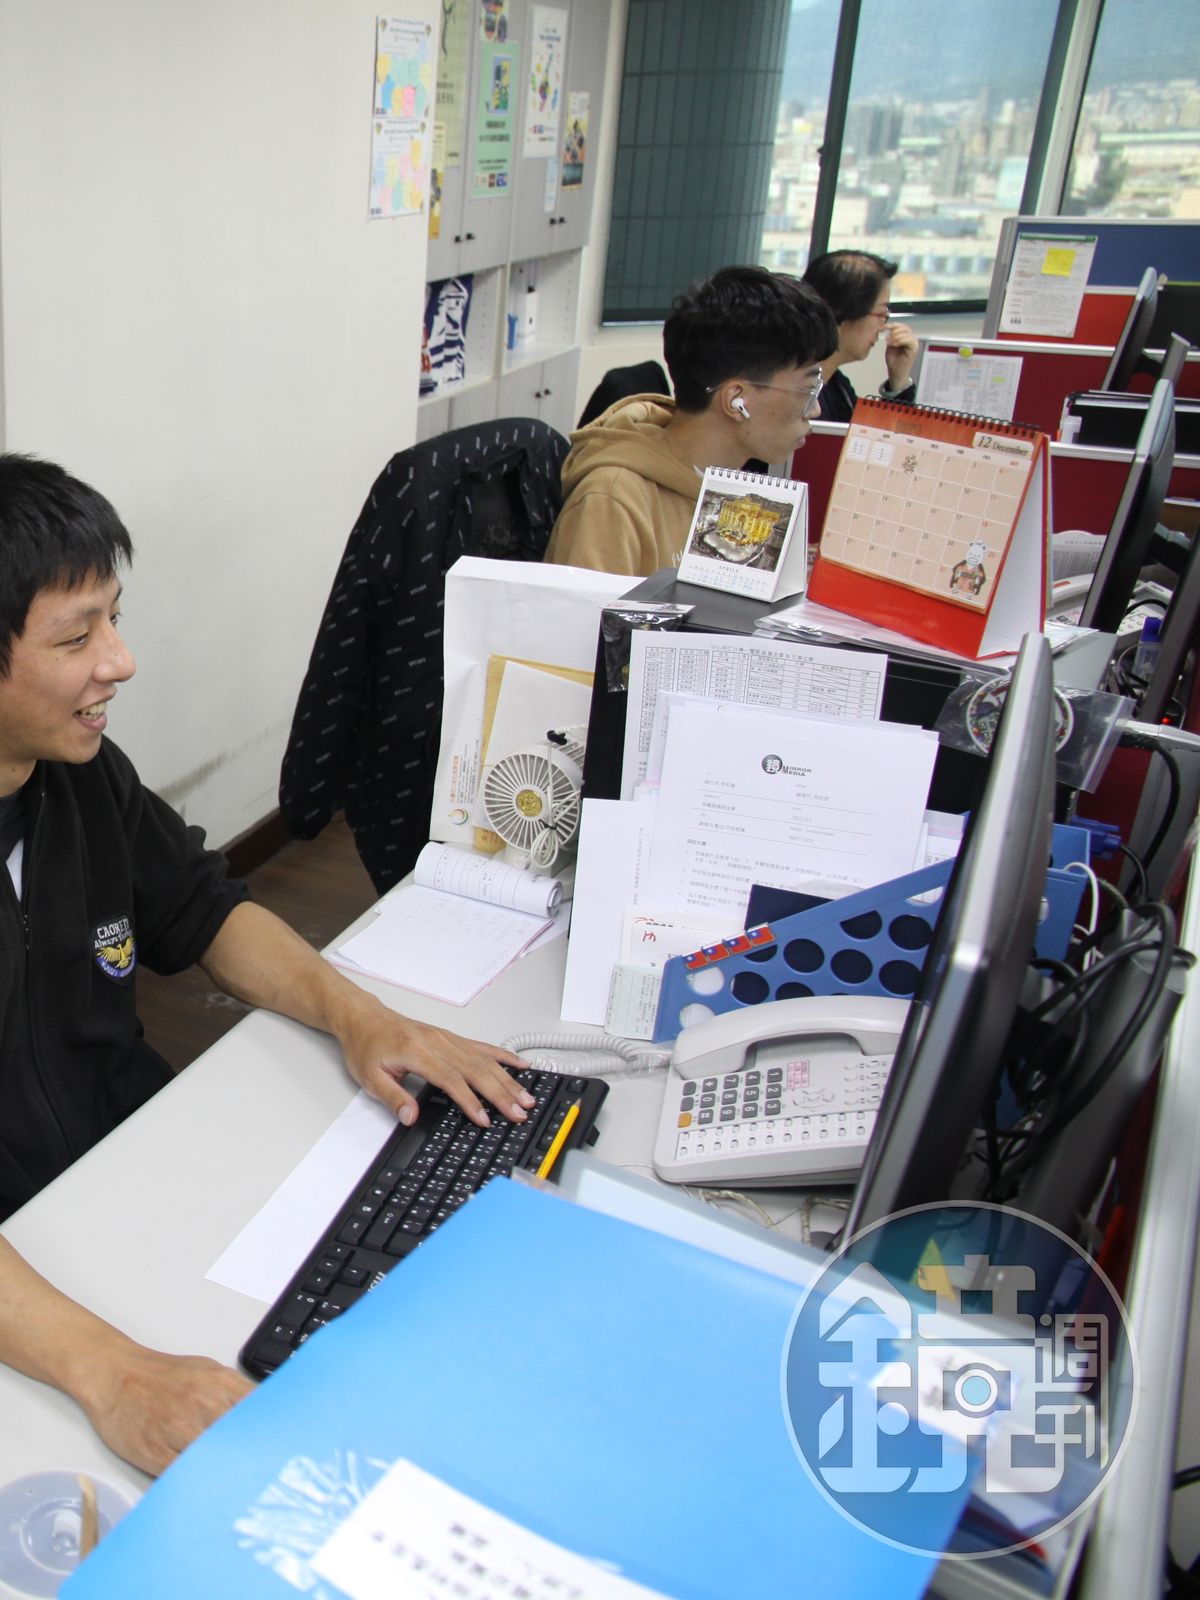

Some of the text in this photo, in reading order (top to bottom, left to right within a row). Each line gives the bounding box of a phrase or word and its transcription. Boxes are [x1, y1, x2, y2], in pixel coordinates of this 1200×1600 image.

[978, 436, 1028, 456] 12 December
[782, 766, 812, 774] MIRROR
